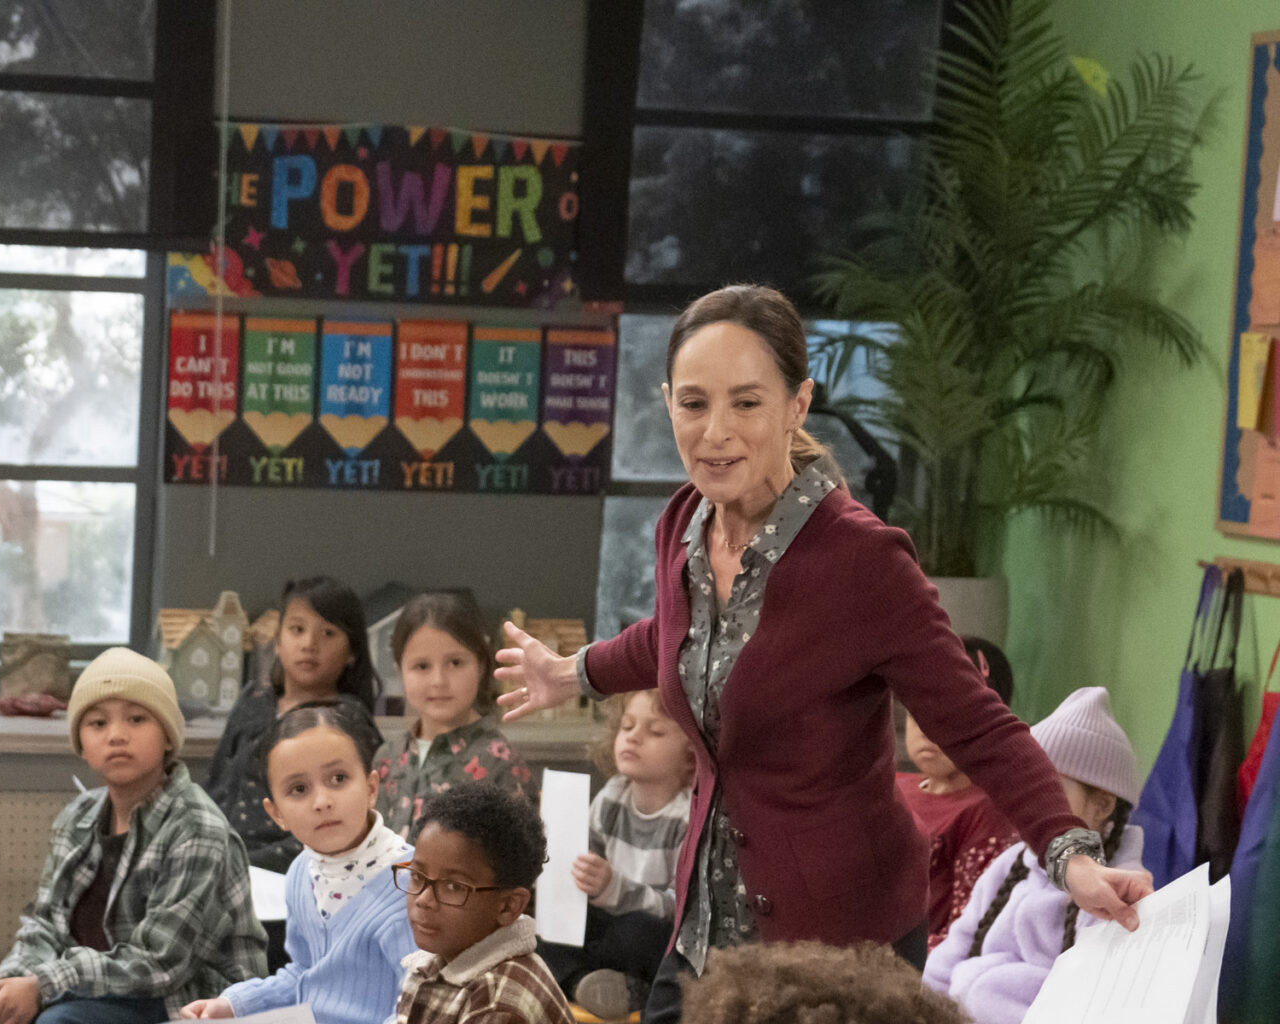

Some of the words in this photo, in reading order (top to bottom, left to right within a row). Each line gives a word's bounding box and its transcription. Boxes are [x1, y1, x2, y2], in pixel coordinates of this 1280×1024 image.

[271, 154, 543, 244] POWER
[325, 239, 473, 297] YET!!!
[199, 335, 206, 351] I
[267, 337, 296, 356] I'M
[343, 341, 372, 358] I'M
[401, 344, 407, 361] I
[410, 343, 464, 361] DON'T
[498, 346, 516, 364] IT
[564, 349, 598, 367] THIS
[175, 356, 230, 374] CAN'T
[248, 361, 274, 375] NOT
[276, 362, 312, 376] GOOD
[338, 363, 374, 380] NOT
[477, 371, 534, 387] DOESN'T
[550, 373, 608, 390] DOESN'T
[170, 380, 193, 398] DO
[197, 381, 235, 399] THIS
[247, 383, 270, 400] AT
[272, 383, 311, 401] THIS
[326, 384, 383, 404] READY
[412, 389, 450, 408] THIS
[480, 392, 529, 409] WORK
[172, 454, 228, 480] YET!
[249, 456, 305, 483] YET!
[325, 459, 381, 485] YET!
[401, 461, 455, 489] YET!
[475, 463, 529, 490] YET!
